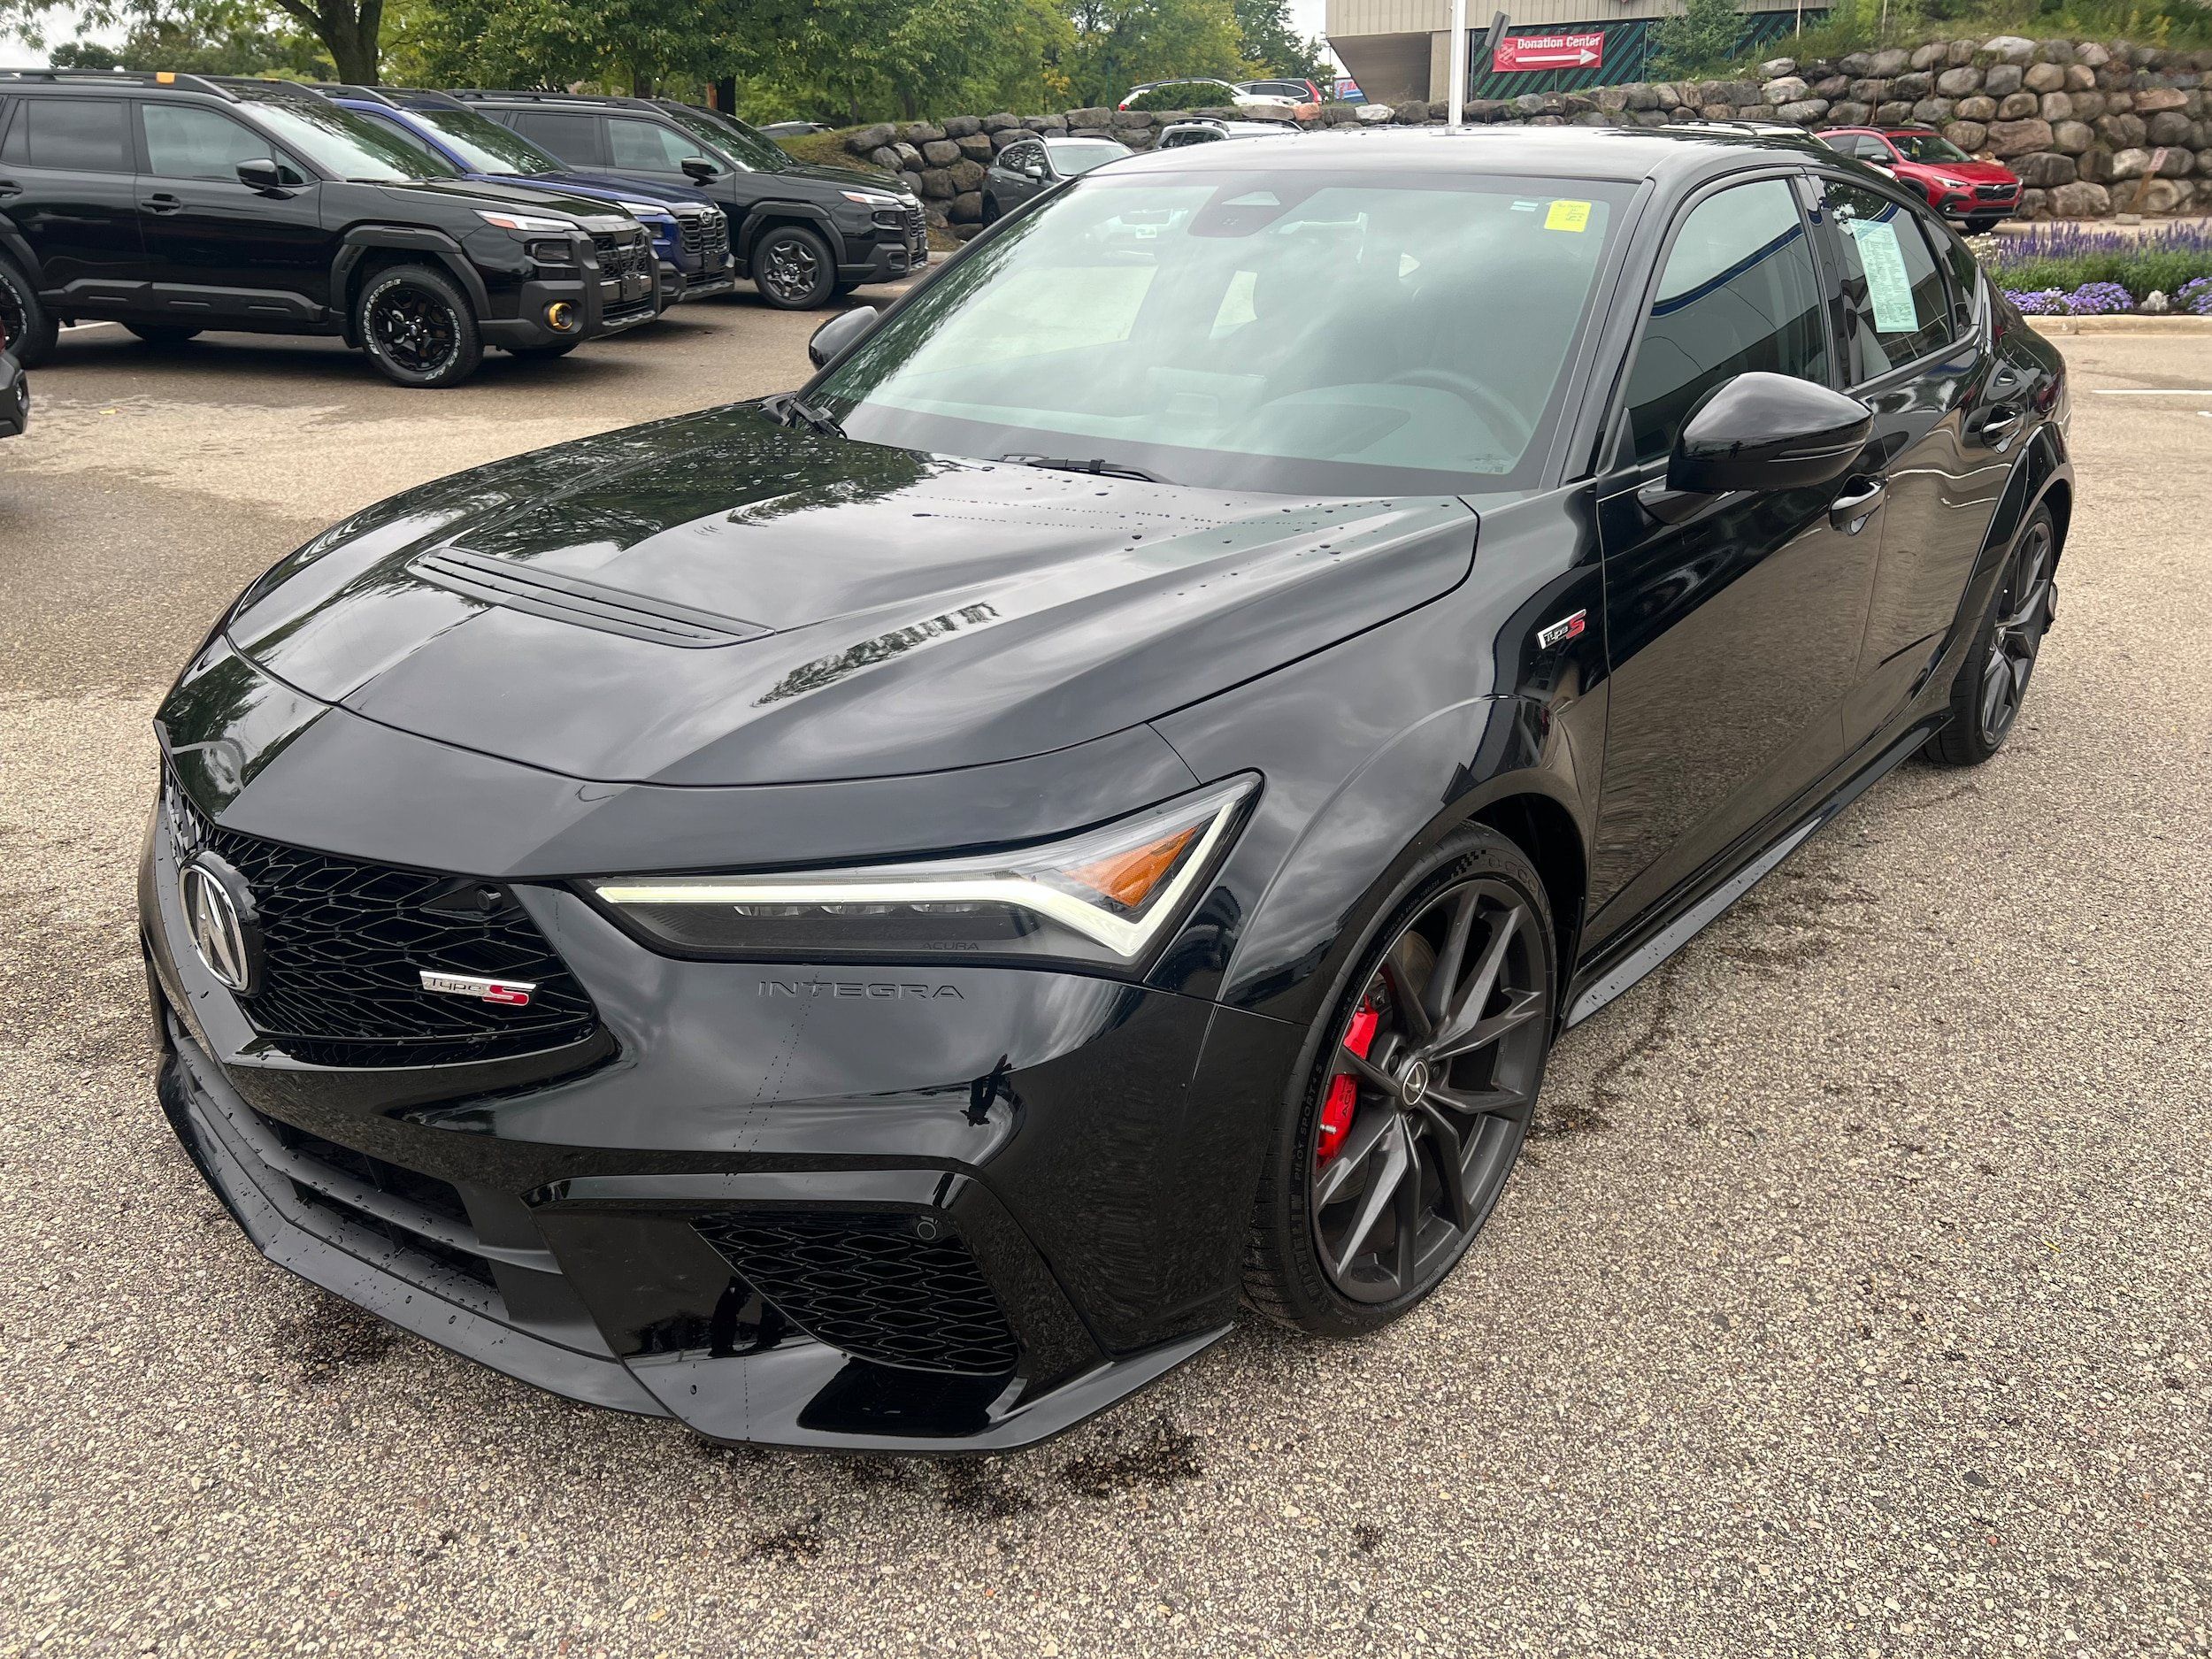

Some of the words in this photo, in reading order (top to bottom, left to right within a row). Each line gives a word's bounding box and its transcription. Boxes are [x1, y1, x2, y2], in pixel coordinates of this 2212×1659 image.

[1517, 37, 1563, 50] Donation
[1566, 35, 1601, 47] Center
[921, 941, 979, 951] ACURA
[431, 978, 481, 991] Type
[482, 984, 530, 1006] S
[758, 980, 966, 1001] INTEGRA
[1294, 1141, 1305, 1181] PILOT
[1300, 1085, 1317, 1135] SPORT
